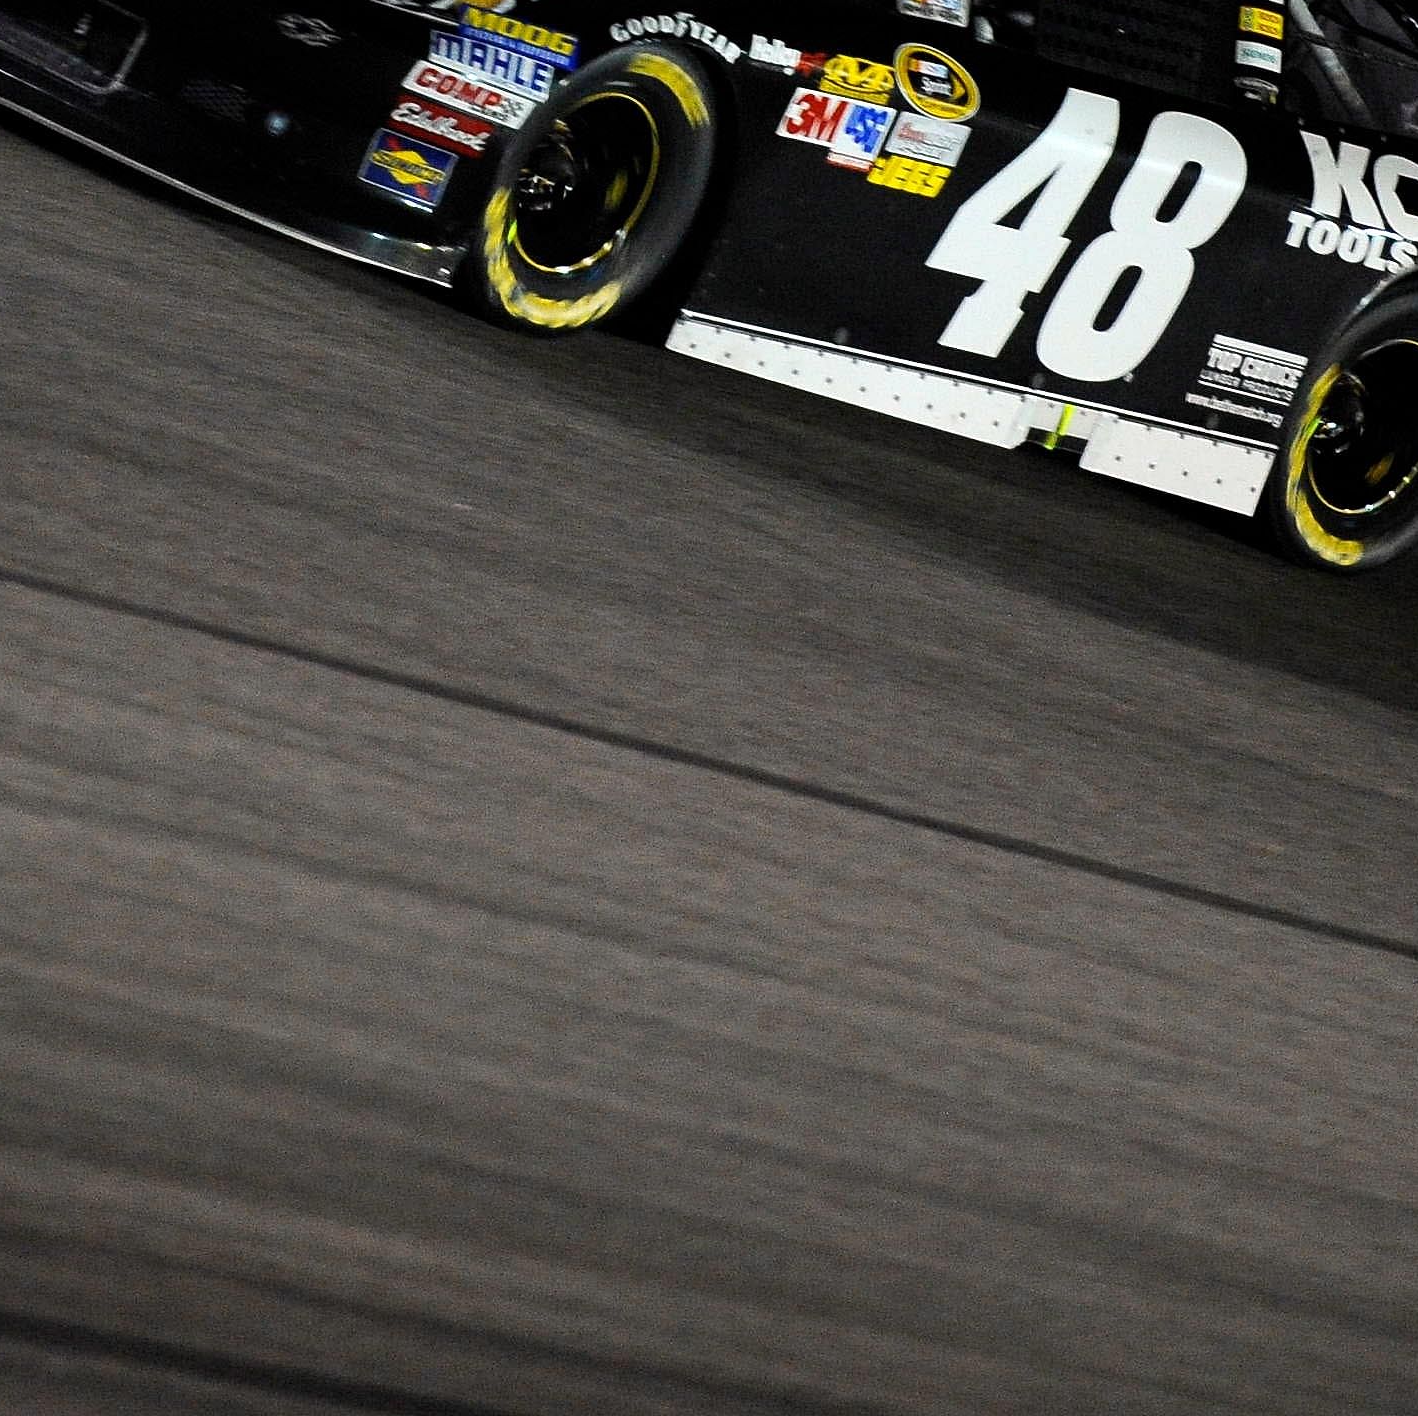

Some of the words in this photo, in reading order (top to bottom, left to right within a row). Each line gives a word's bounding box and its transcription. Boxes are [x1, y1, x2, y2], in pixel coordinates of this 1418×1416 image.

[466, 7, 577, 56] MOOG
[609, 11, 741, 64] GOODYEAR
[416, 67, 502, 107] COMP
[432, 33, 549, 93] MAHLE
[786, 92, 849, 143] 3M
[925, 87, 1247, 383] 48
[1287, 210, 1418, 276] TOOLS
